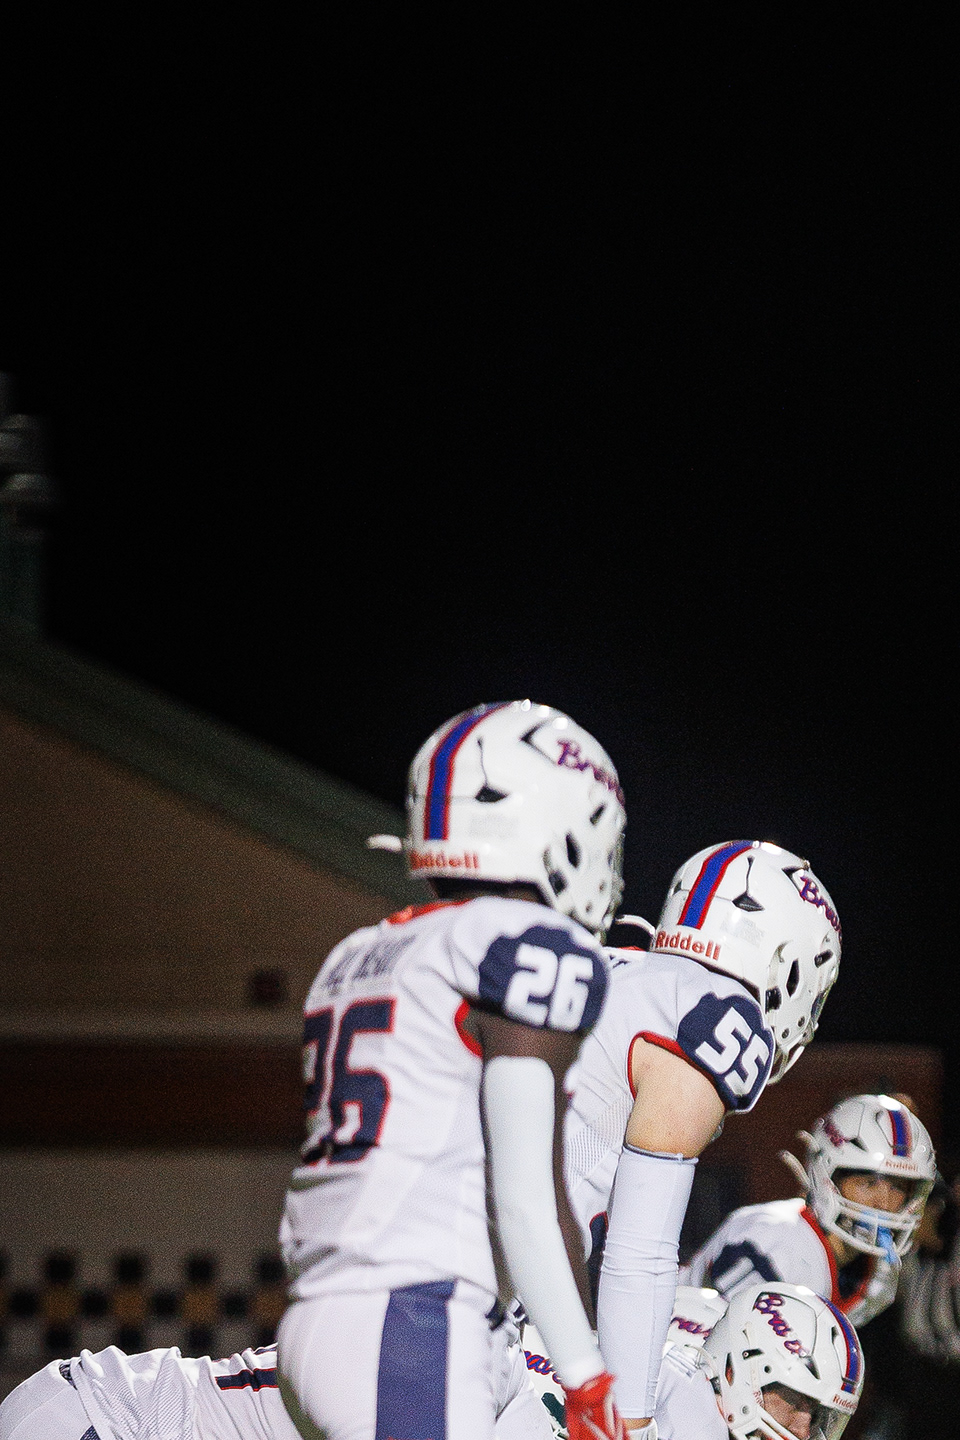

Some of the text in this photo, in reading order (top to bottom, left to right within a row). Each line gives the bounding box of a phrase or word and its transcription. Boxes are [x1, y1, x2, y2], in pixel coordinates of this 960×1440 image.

[505, 942, 595, 1033] 26
[655, 930, 721, 961] Riddell
[695, 1006, 770, 1097] 55
